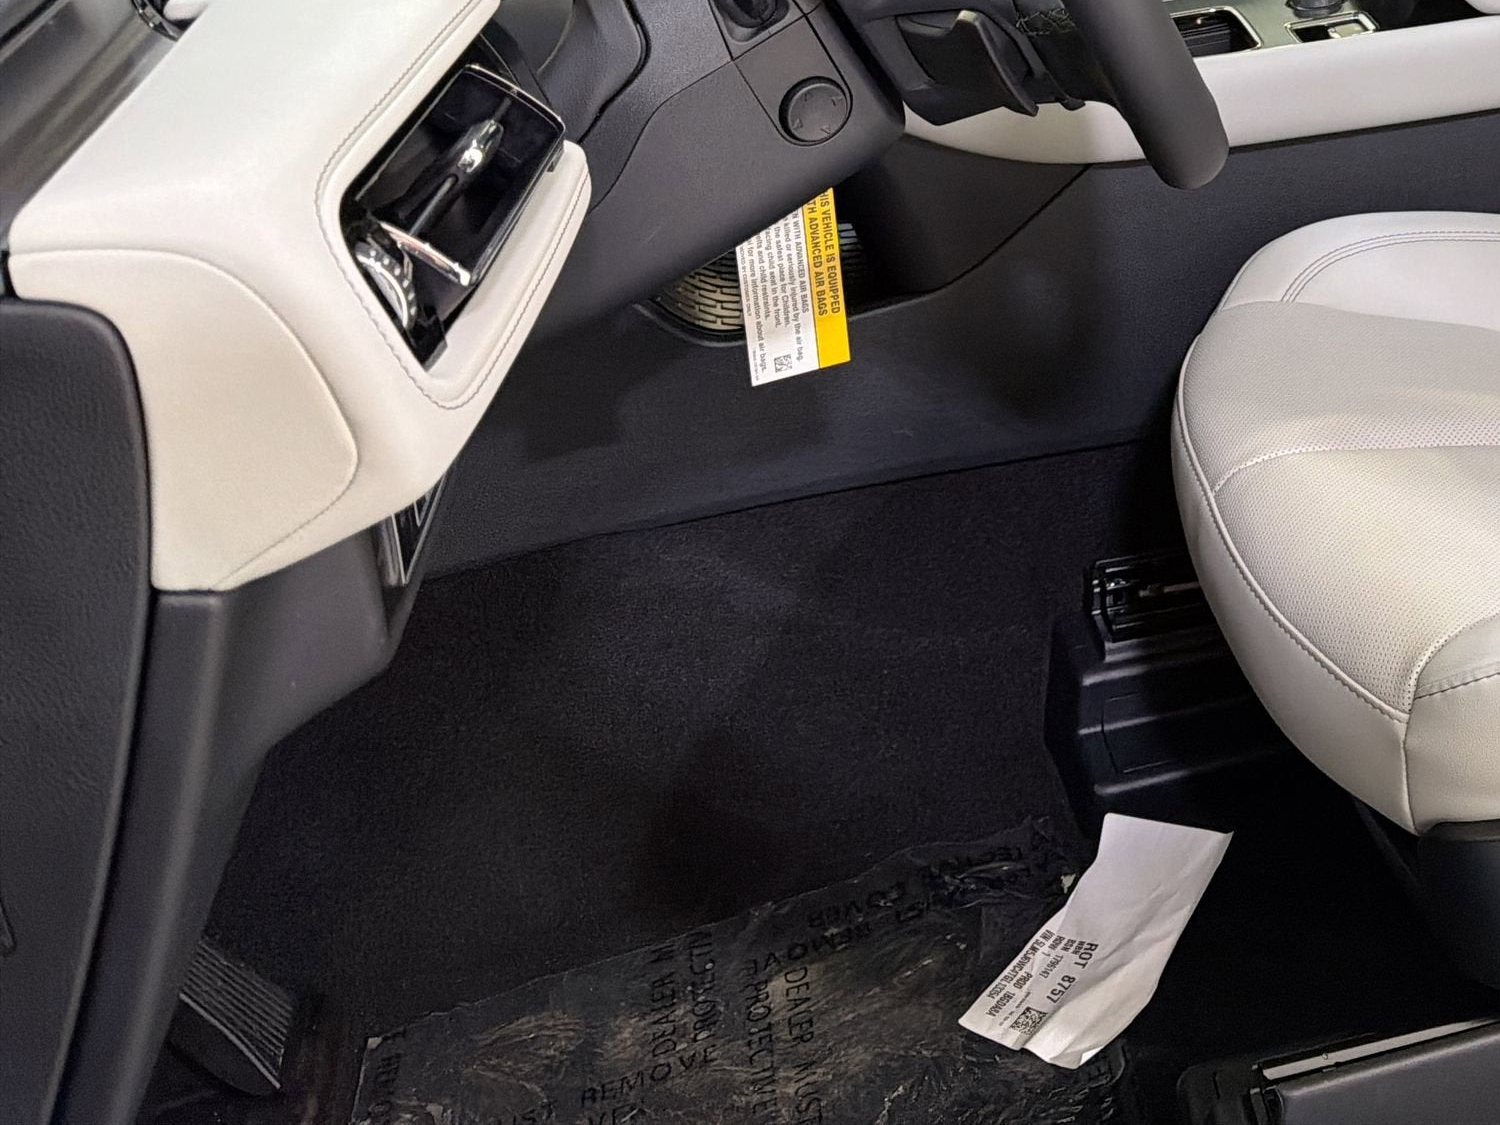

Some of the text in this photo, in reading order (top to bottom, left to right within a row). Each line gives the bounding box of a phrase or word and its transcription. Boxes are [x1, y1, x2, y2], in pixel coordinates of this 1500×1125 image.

[755, 234, 763, 248] elts
[774, 238, 783, 261] safest
[818, 191, 840, 314] HIS VEHICLE IS EQUIPPED
[748, 258, 756, 277] more
[785, 252, 796, 286] seriously
[806, 199, 827, 316] TH ADVANCED AIR BAGS
[766, 251, 775, 270] child
[771, 295, 779, 307] the
[777, 262, 785, 282] place
[794, 240, 804, 278] ADVANCED
[800, 293, 808, 313] BAGS
[750, 278, 761, 320] information
[779, 282, 787, 294] for
[789, 285, 798, 312] injured
[792, 312, 799, 322] by
[793, 323, 801, 335] the
[755, 320, 763, 341] about
[1039, 929, 1055, 942] VIN
[1073, 941, 1098, 968] ROT
[1012, 970, 1033, 990] PROD
[1045, 973, 1076, 1003] 8757
[784, 966, 815, 1048] DEALER
